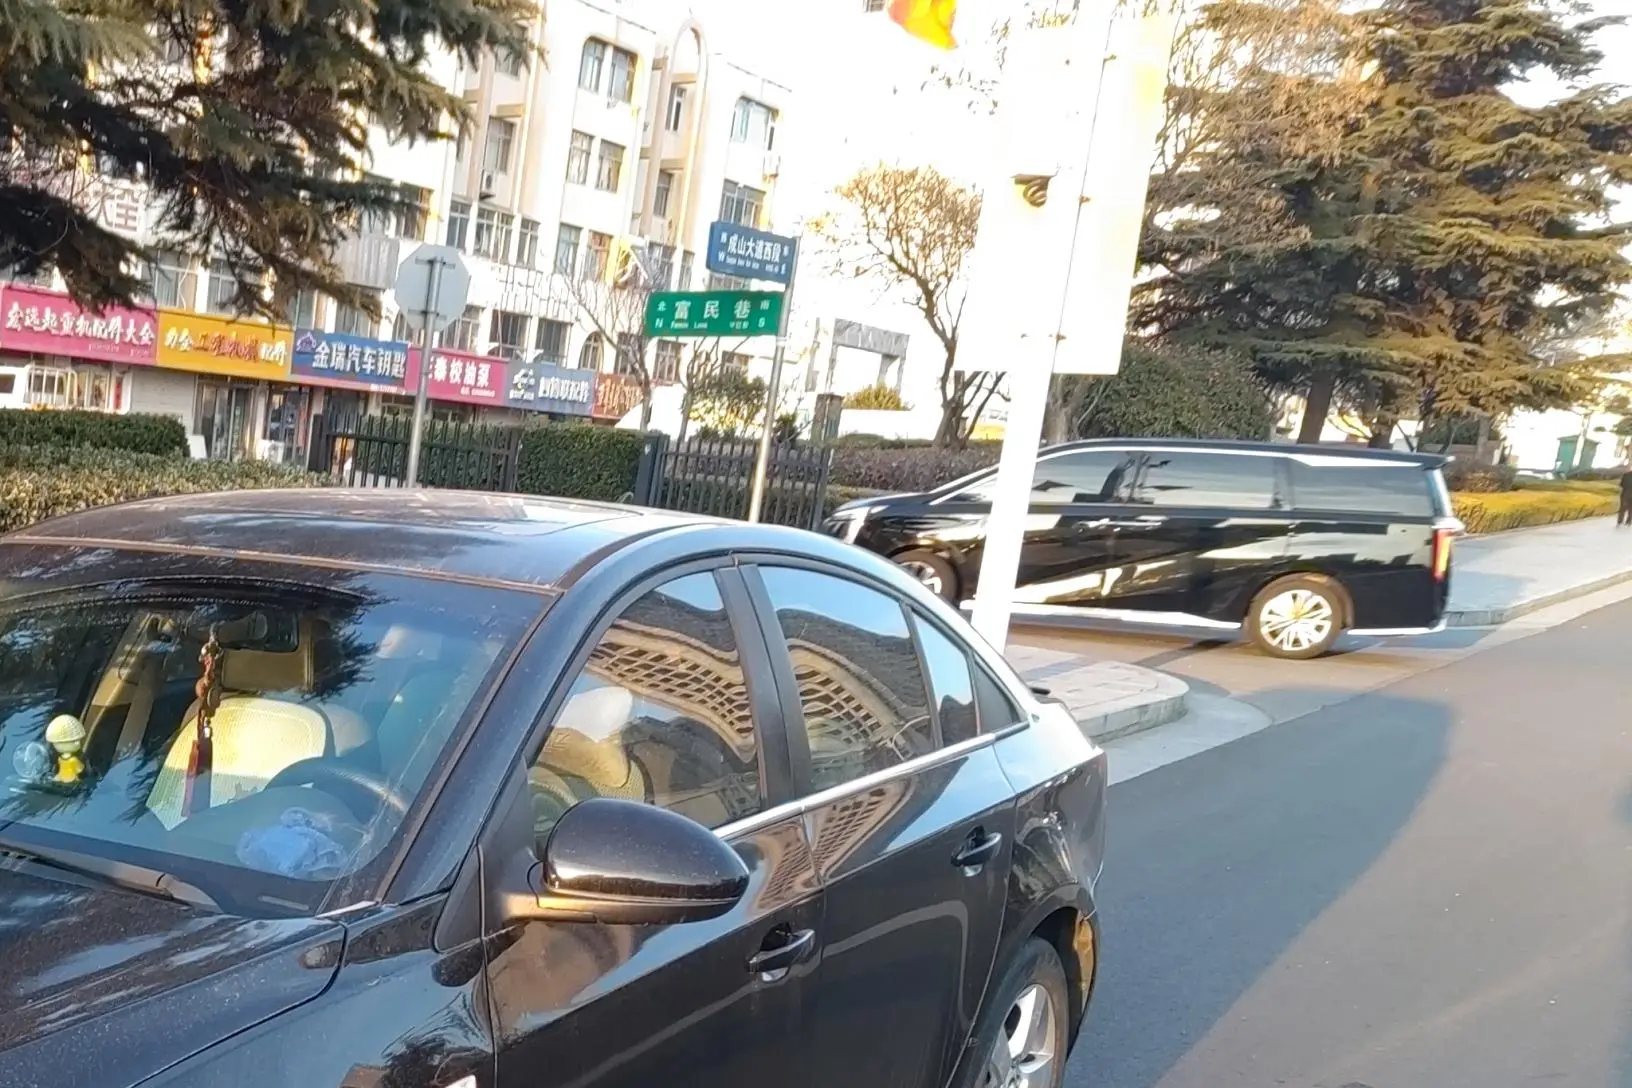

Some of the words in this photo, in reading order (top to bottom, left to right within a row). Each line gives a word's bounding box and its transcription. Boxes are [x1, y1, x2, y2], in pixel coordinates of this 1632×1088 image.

[727, 232, 782, 264] 成山大道西段
[673, 299, 752, 320] 富民巷
[654, 317, 664, 329] N
[312, 341, 407, 379] 金瑞汽车钥匙
